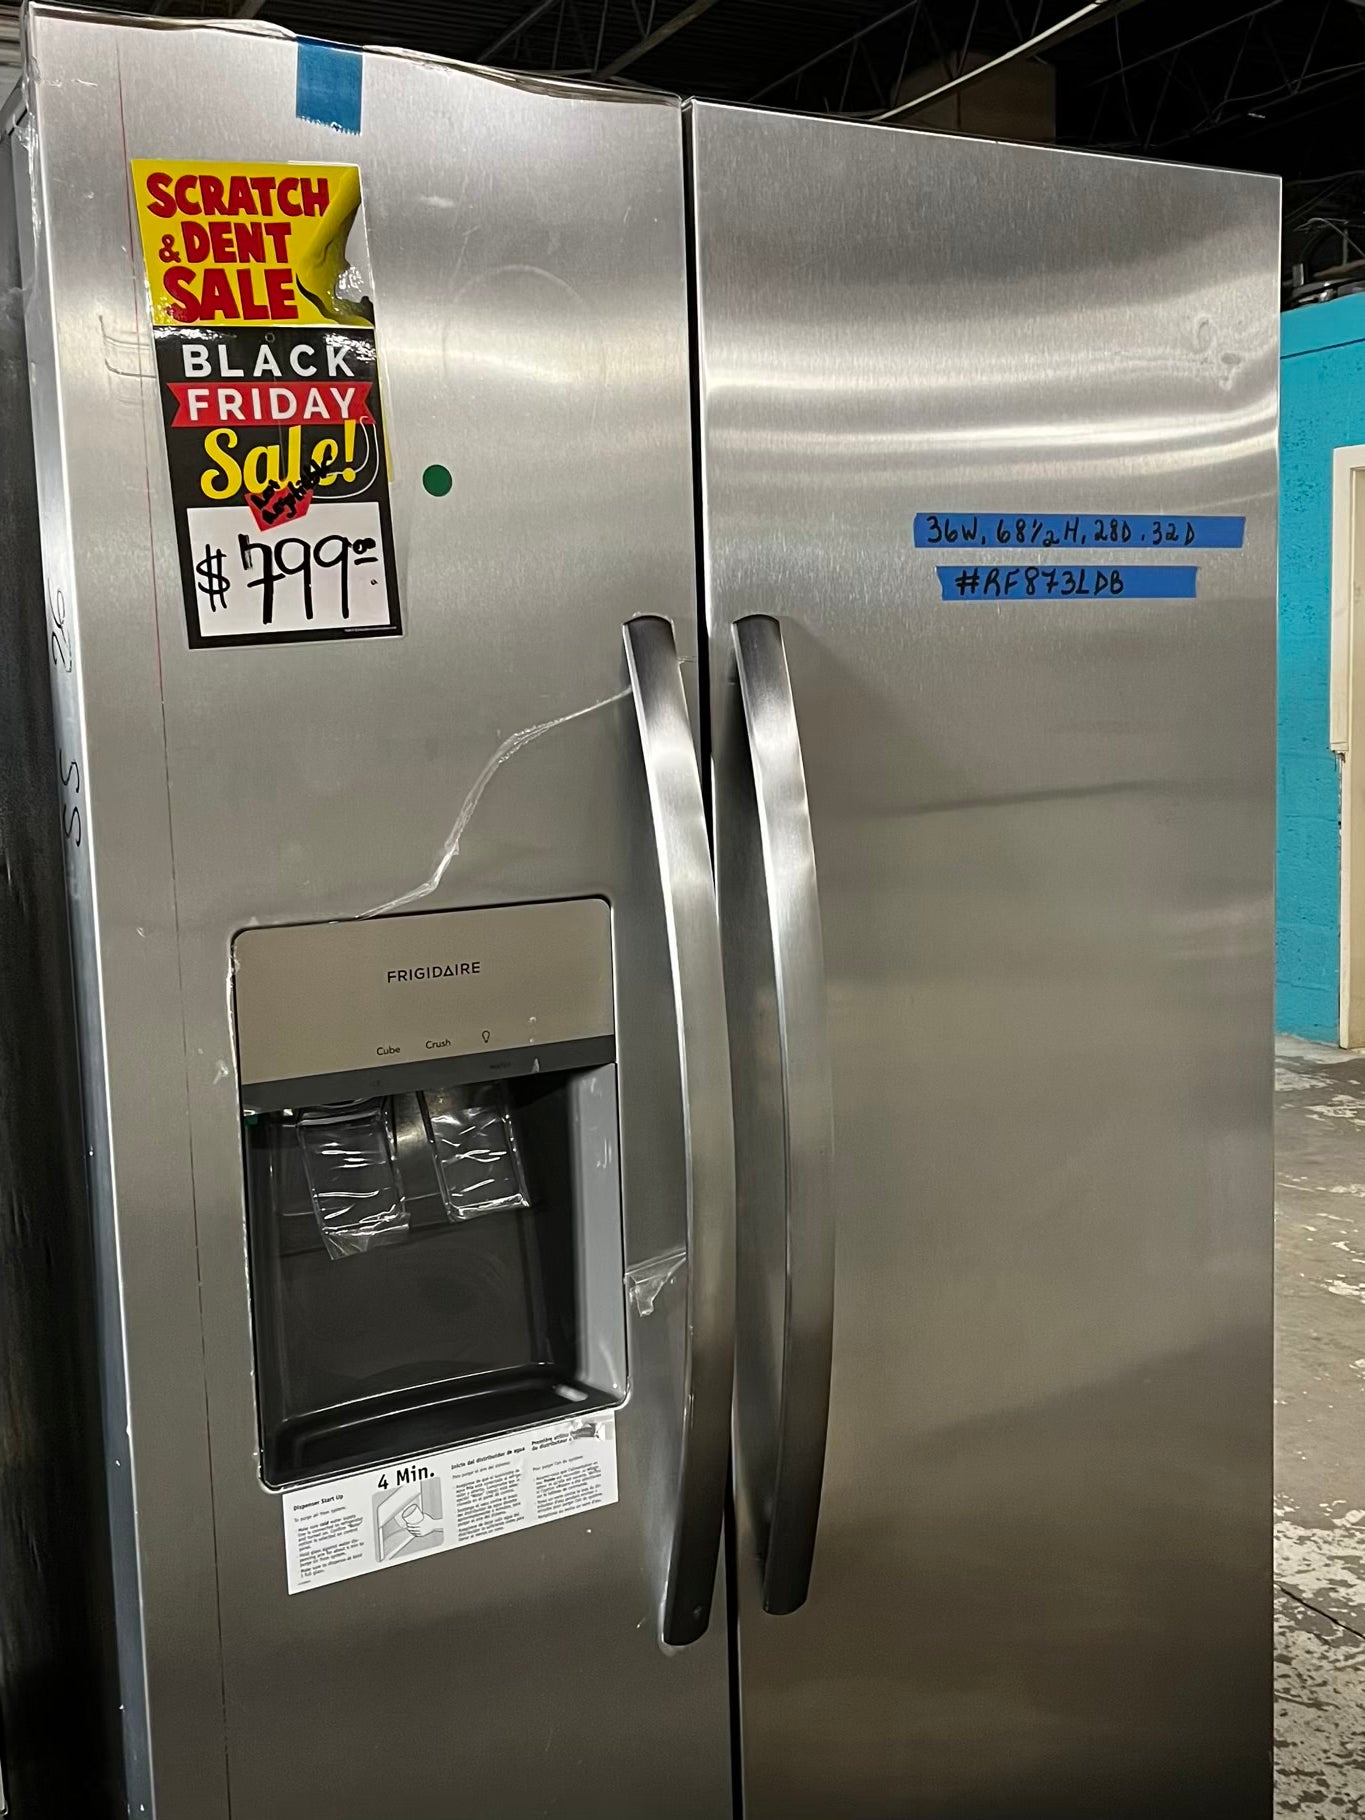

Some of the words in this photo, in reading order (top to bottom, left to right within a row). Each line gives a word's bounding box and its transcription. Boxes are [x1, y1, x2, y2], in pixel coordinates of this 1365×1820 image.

[146, 171, 330, 219] SCRATCH
[158, 234, 181, 263] &
[181, 221, 292, 264] DENT
[163, 266, 299, 323] SALE
[181, 343, 356, 379] BLACK
[187, 386, 356, 422] FRIDAY
[200, 419, 356, 500] Sale!
[954, 566, 1125, 597] #RF873LDB
[386, 960, 482, 984] FRIGIDAIRE
[375, 1045, 401, 1056] Cube
[424, 1038, 452, 1050] Crush
[377, 1472, 389, 1491] 4
[395, 1464, 435, 1487] Min.
[293, 1500, 320, 1511] Dispenser
[320, 1496, 335, 1504] Start
